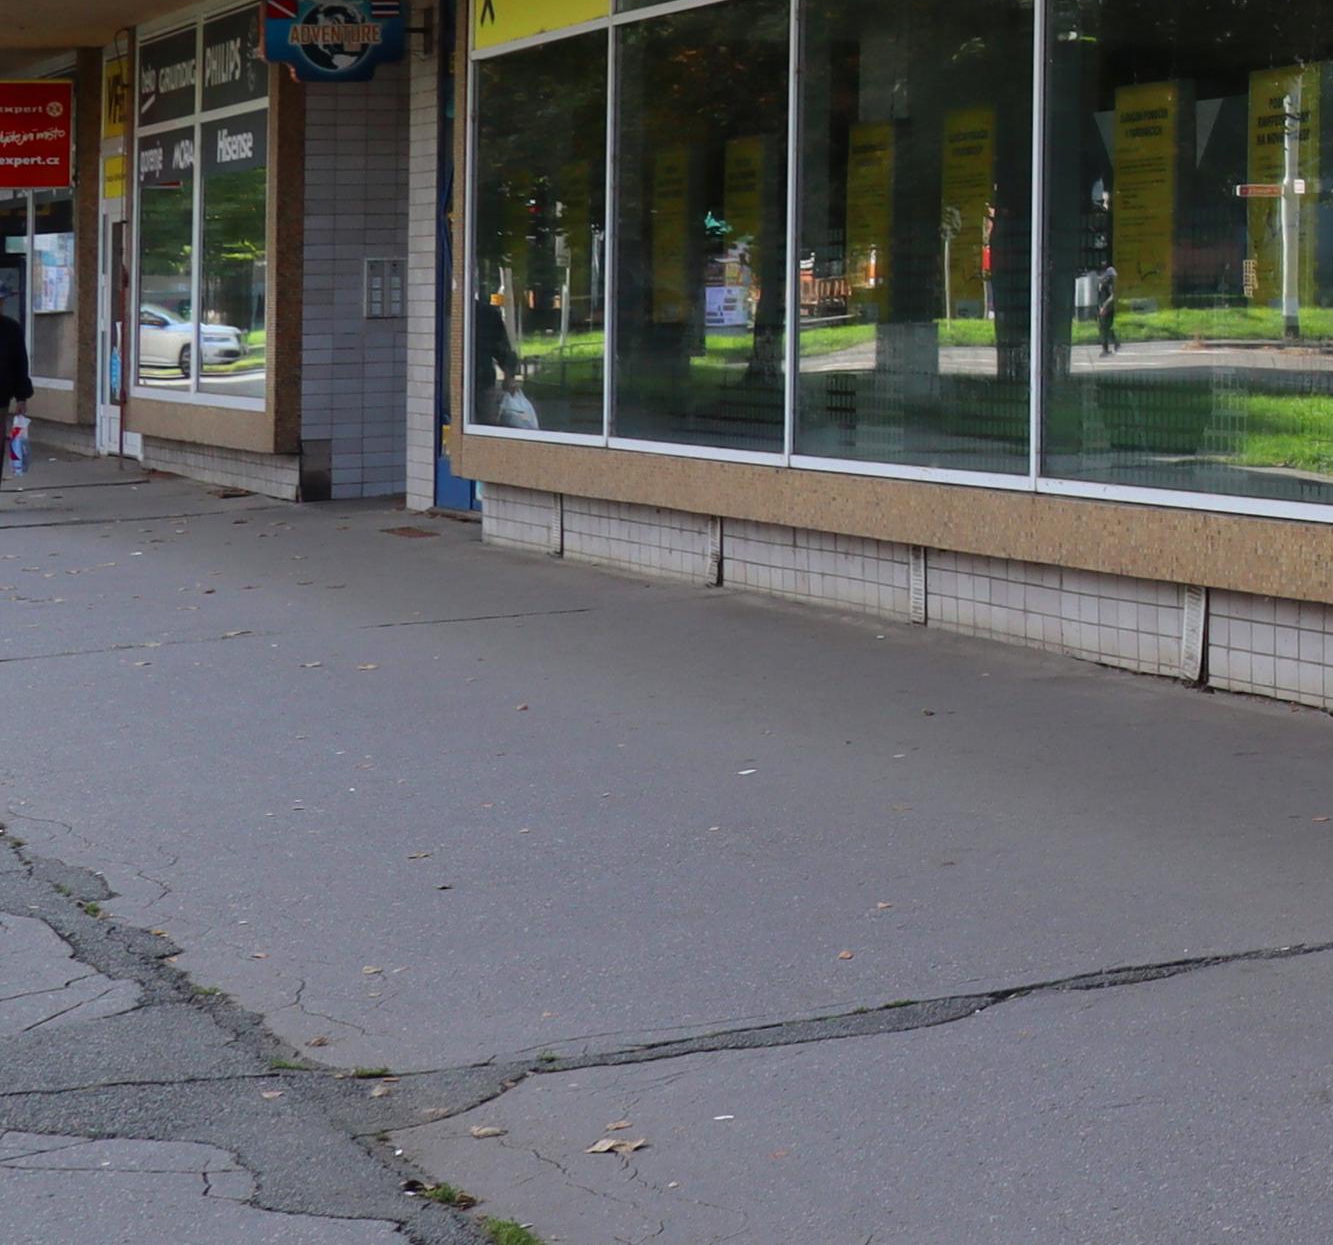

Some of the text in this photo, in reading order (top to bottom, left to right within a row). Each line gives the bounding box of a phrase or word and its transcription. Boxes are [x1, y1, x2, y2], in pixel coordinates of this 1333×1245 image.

[290, 24, 380, 44] ADVENTURE
[205, 37, 242, 88] PHILIPS
[217, 128, 254, 164] Hisense
